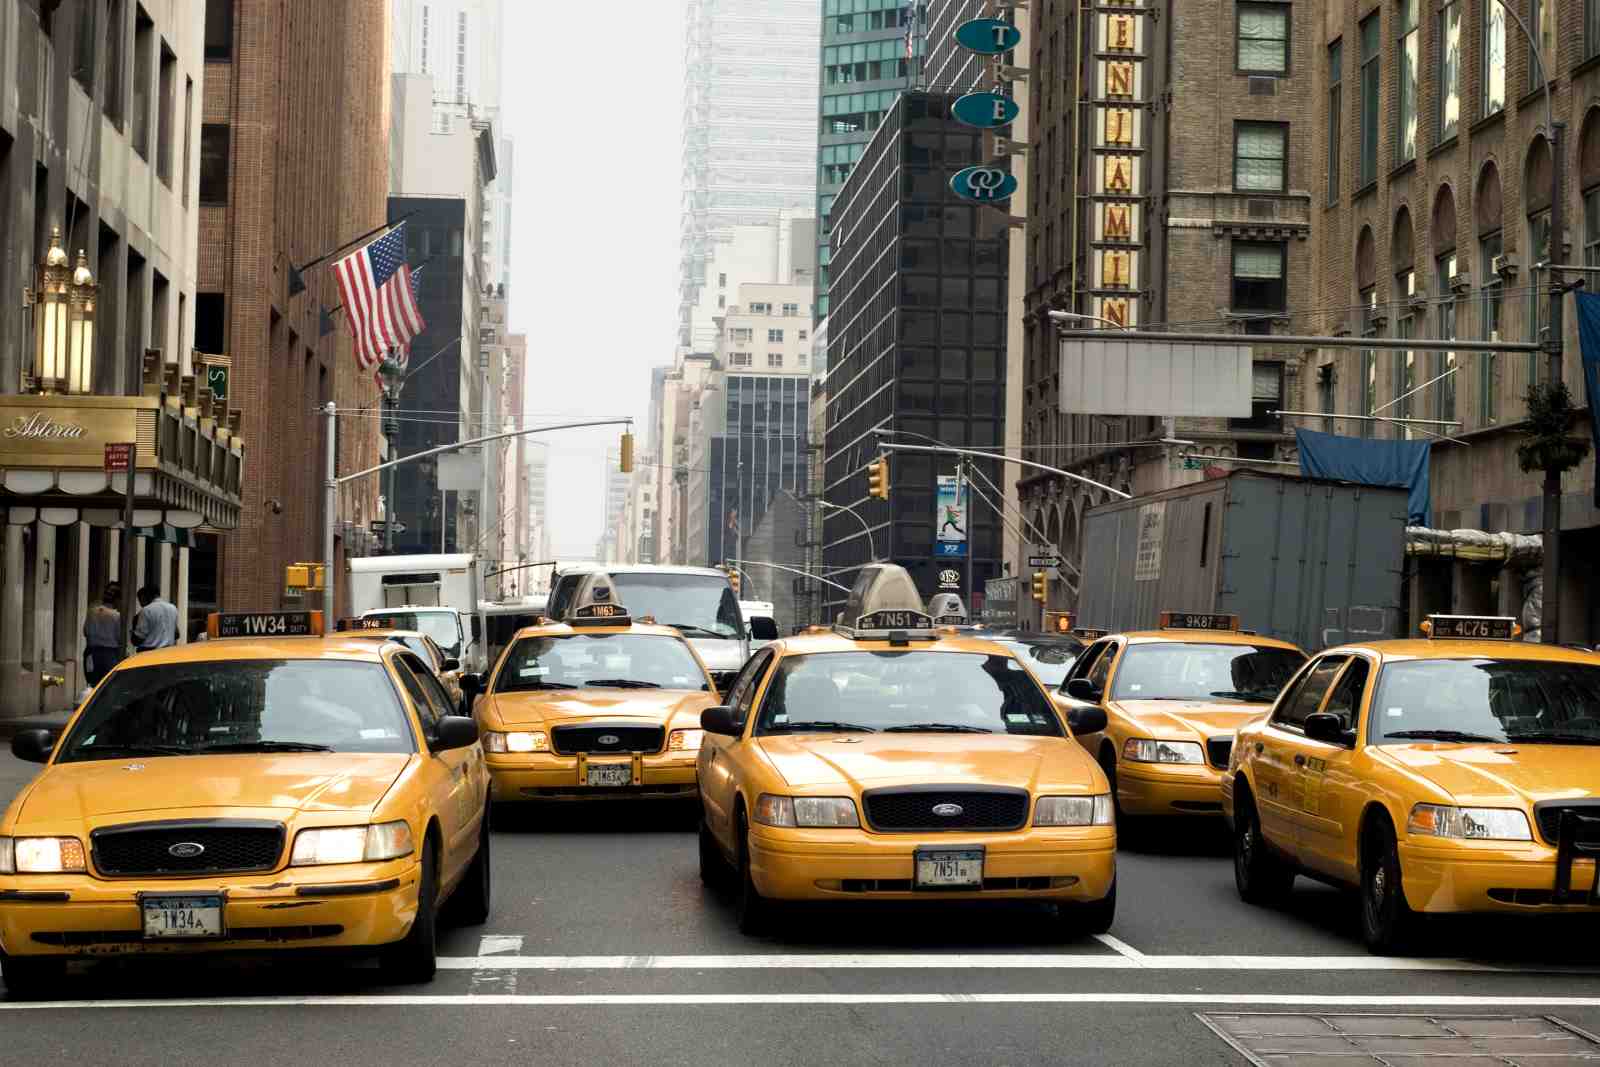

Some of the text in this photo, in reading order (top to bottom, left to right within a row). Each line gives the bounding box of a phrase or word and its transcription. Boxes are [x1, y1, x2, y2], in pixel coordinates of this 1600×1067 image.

[3, 411, 86, 440] Astoria
[242, 614, 287, 633] 1W34
[878, 612, 911, 626] 7N51
[1186, 615, 1213, 628] 9K87
[1455, 620, 1489, 637] 4C76
